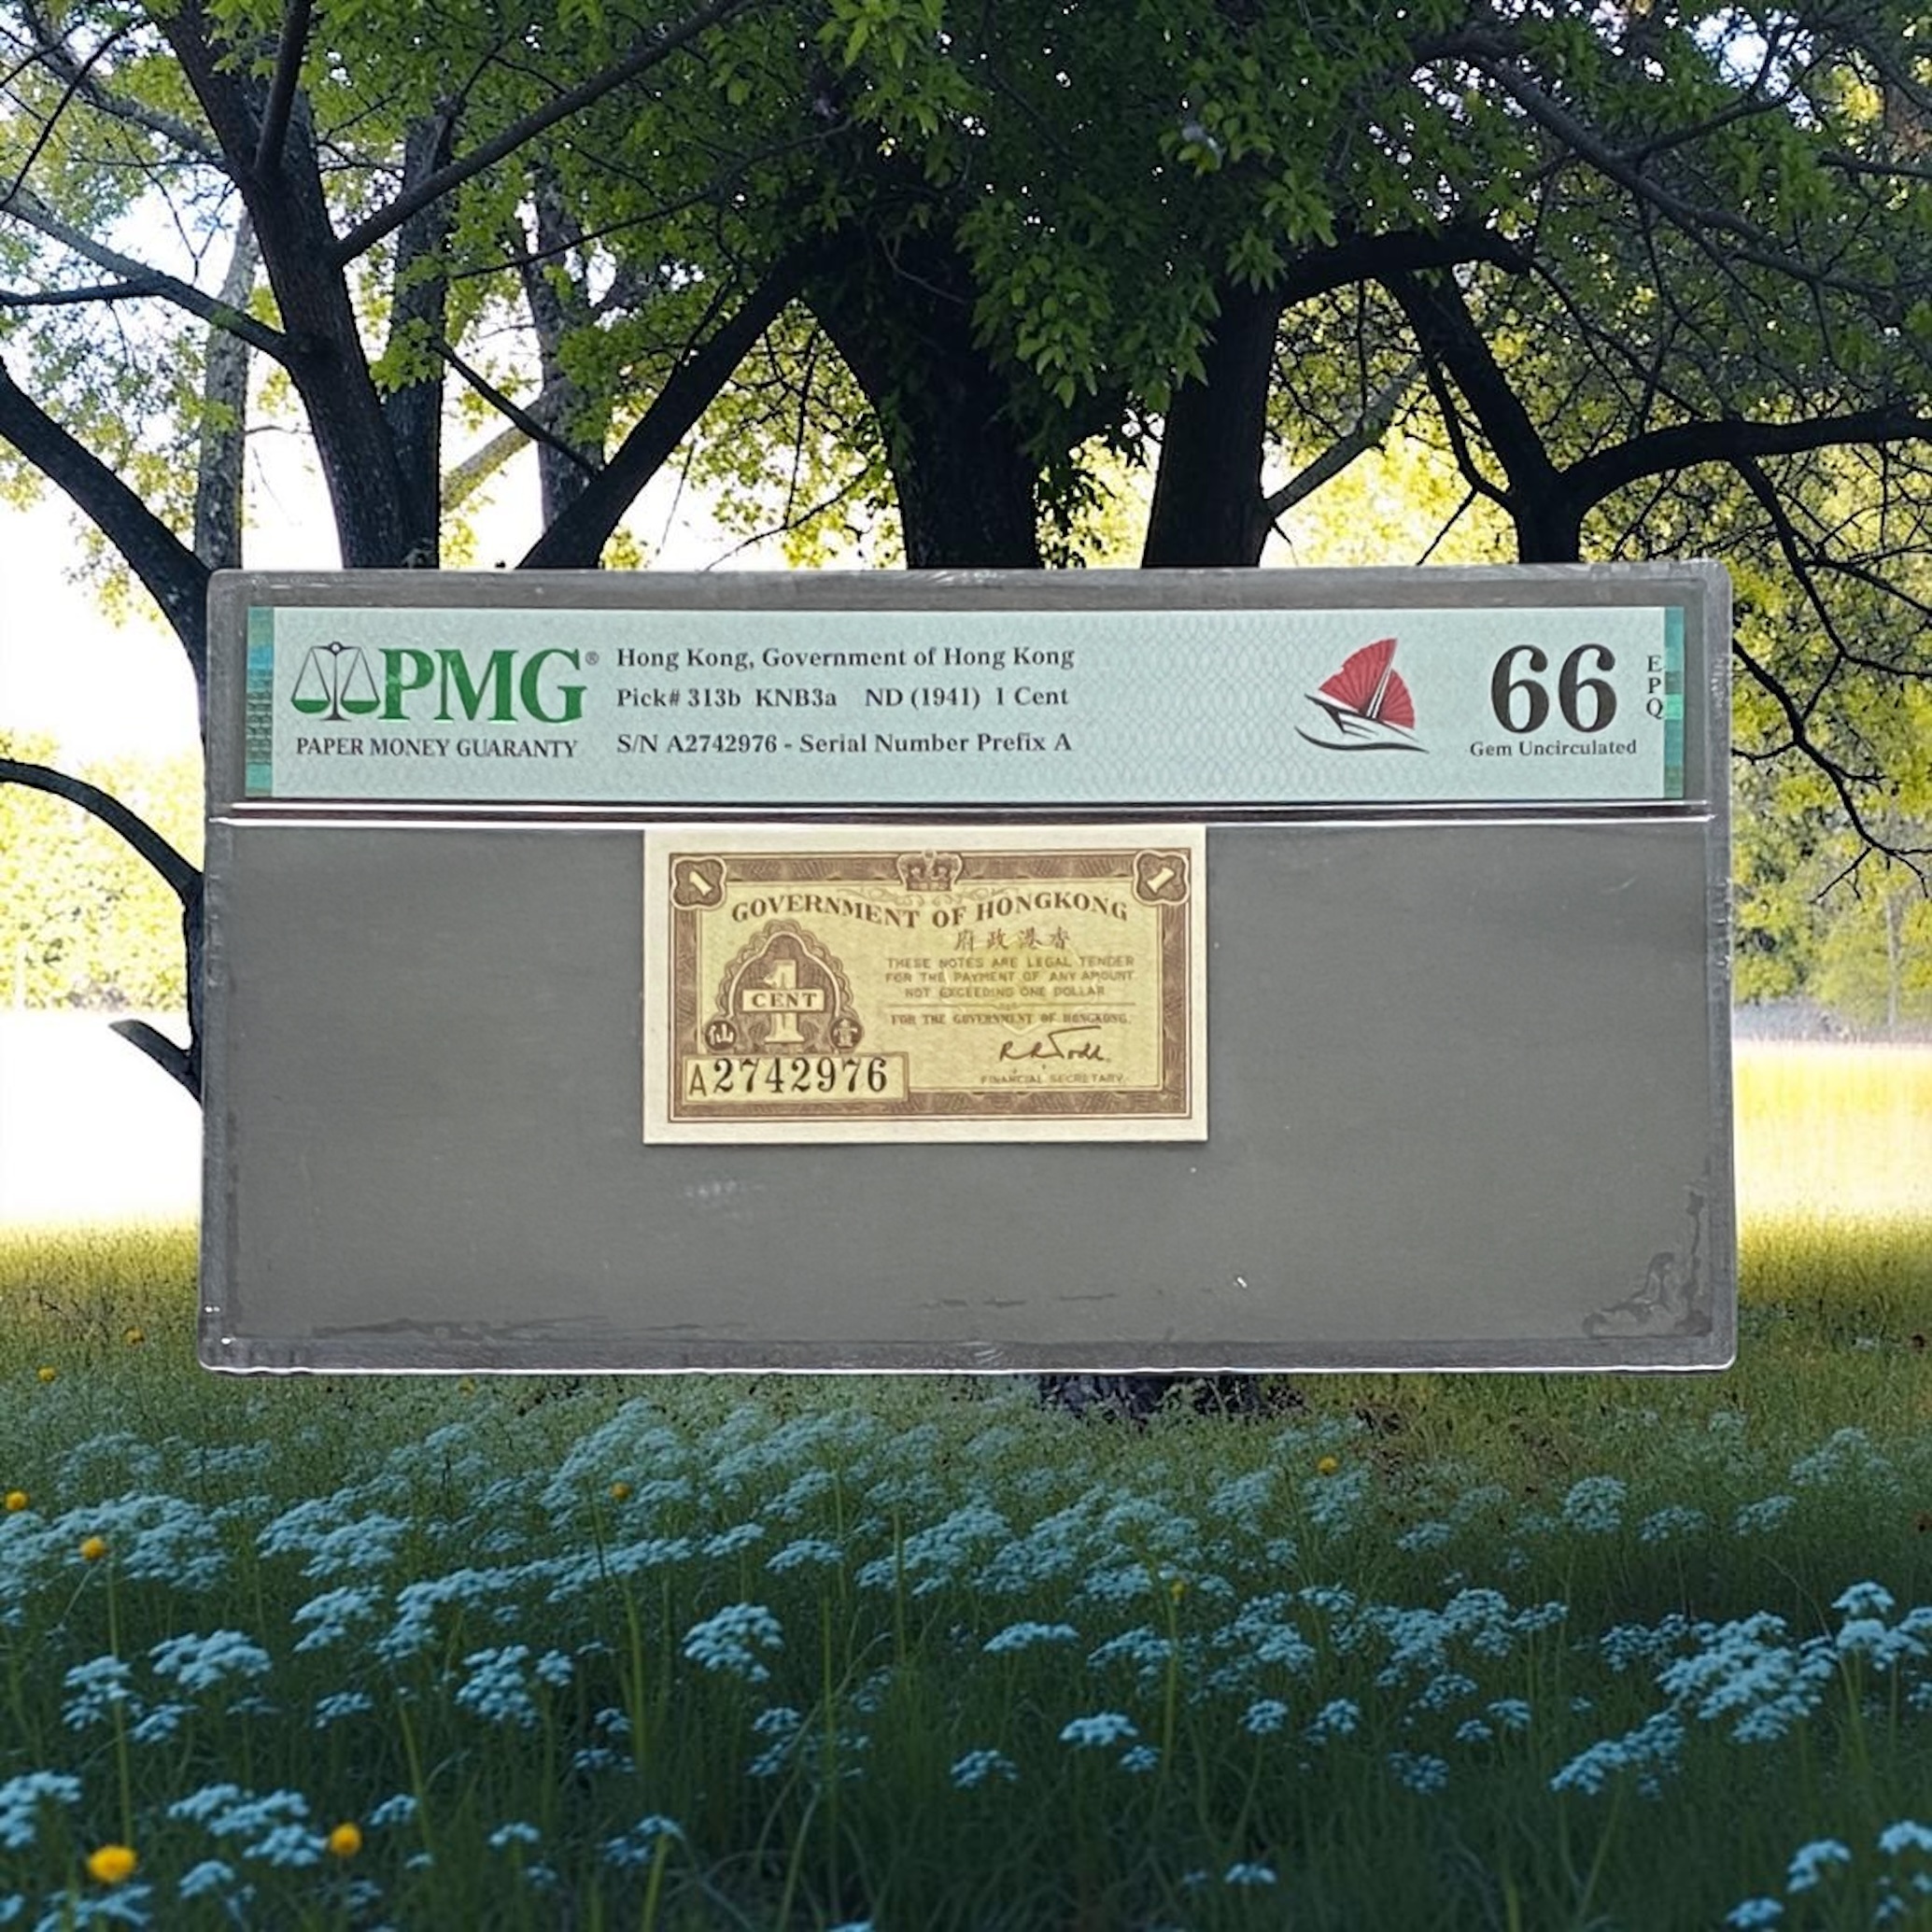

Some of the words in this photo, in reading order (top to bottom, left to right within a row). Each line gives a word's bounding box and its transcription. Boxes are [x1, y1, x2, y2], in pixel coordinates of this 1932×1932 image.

[617, 648, 679, 671] Hong
[686, 648, 754, 671] Kong,
[763, 647, 907, 667] Government
[913, 646, 937, 666] of
[944, 647, 1006, 670] Hong
[1013, 646, 1075, 670] Kong
[378, 648, 587, 723] PMG
[1491, 642, 1617, 734] 66
[617, 688, 681, 707] Pick#
[687, 688, 740, 707] 313b
[755, 688, 837, 707] KNB3a
[865, 688, 903, 707] ND
[910, 686, 981, 710] (1941)
[1014, 687, 1068, 706] Cent
[297, 737, 363, 756] PAPER
[371, 738, 451, 757] MONEY
[457, 739, 577, 758] GUARANTY
[617, 734, 658, 754] S/N
[666, 735, 778, 754] A2742976
[799, 734, 866, 753] Serial
[874, 734, 969, 753] Number
[977, 733, 1046, 752] Prefix
[1054, 734, 1072, 752] A
[1470, 741, 1513, 757] Gem
[1519, 740, 1637, 756] Uncirculated
[732, 894, 921, 929] GOVERNMENT
[933, 906, 966, 928] OF
[977, 891, 1128, 922] HONGKONG
[888, 957, 930, 968] THESE
[939, 957, 983, 968] NOTES
[991, 956, 1018, 968] ARE
[1027, 956, 1071, 967] LEGAL
[1079, 955, 1135, 967] TENDER
[885, 972, 912, 983] FOR
[921, 972, 945, 982] THE
[954, 971, 1014, 982] PAYMENT
[1022, 971, 1039, 981] OF
[1050, 971, 1076, 981] ANY
[1081, 969, 1134, 981] AMOUNT
[751, 992, 818, 1008] CENT
[905, 987, 931, 998] NOT
[939, 986, 1014, 998] EXCEEDING
[1020, 986, 1046, 997] ONE
[1053, 985, 1106, 997] DOLLAR
[891, 1014, 917, 1025] FOR
[923, 1014, 946, 1024] THE
[952, 1013, 1033, 1025] GOVERNMENT
[1040, 1013, 1055, 1024] OF
[980, 1075, 1041, 1084] FINANCIAL
